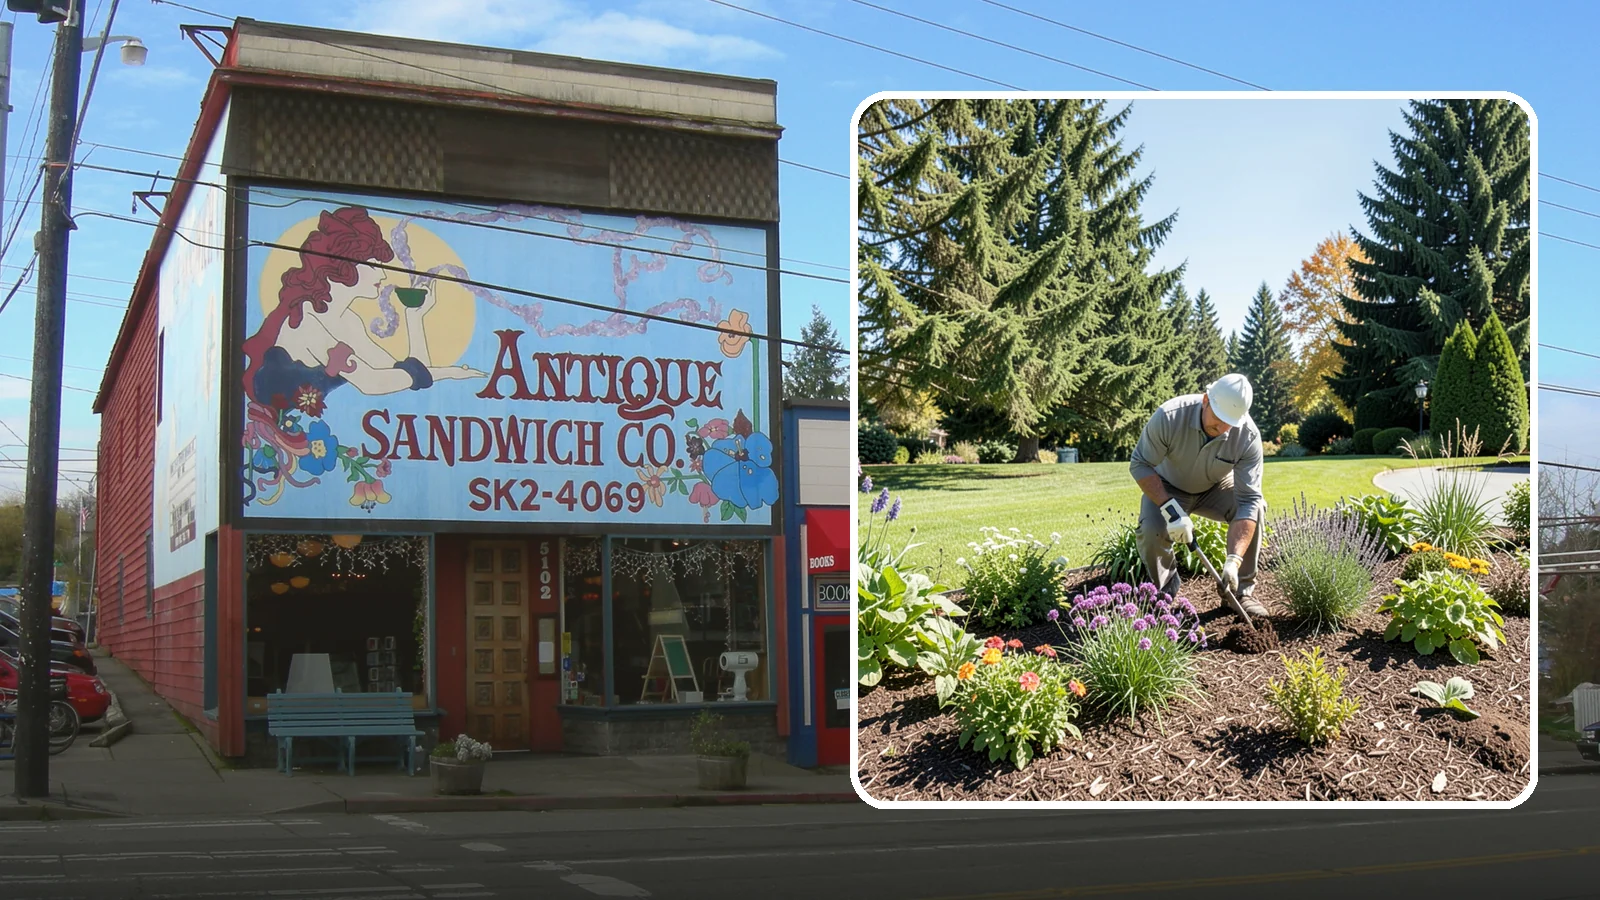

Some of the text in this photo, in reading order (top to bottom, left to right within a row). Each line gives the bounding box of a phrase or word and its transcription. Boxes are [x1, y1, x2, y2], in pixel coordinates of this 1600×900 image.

[475, 329, 723, 421] ANTIQUE
[361, 408, 685, 469] SANDWICH CO.
[468, 478, 645, 514] SK2-4069
[540, 541, 551, 600] 5102
[809, 554, 835, 569] BOOKS
